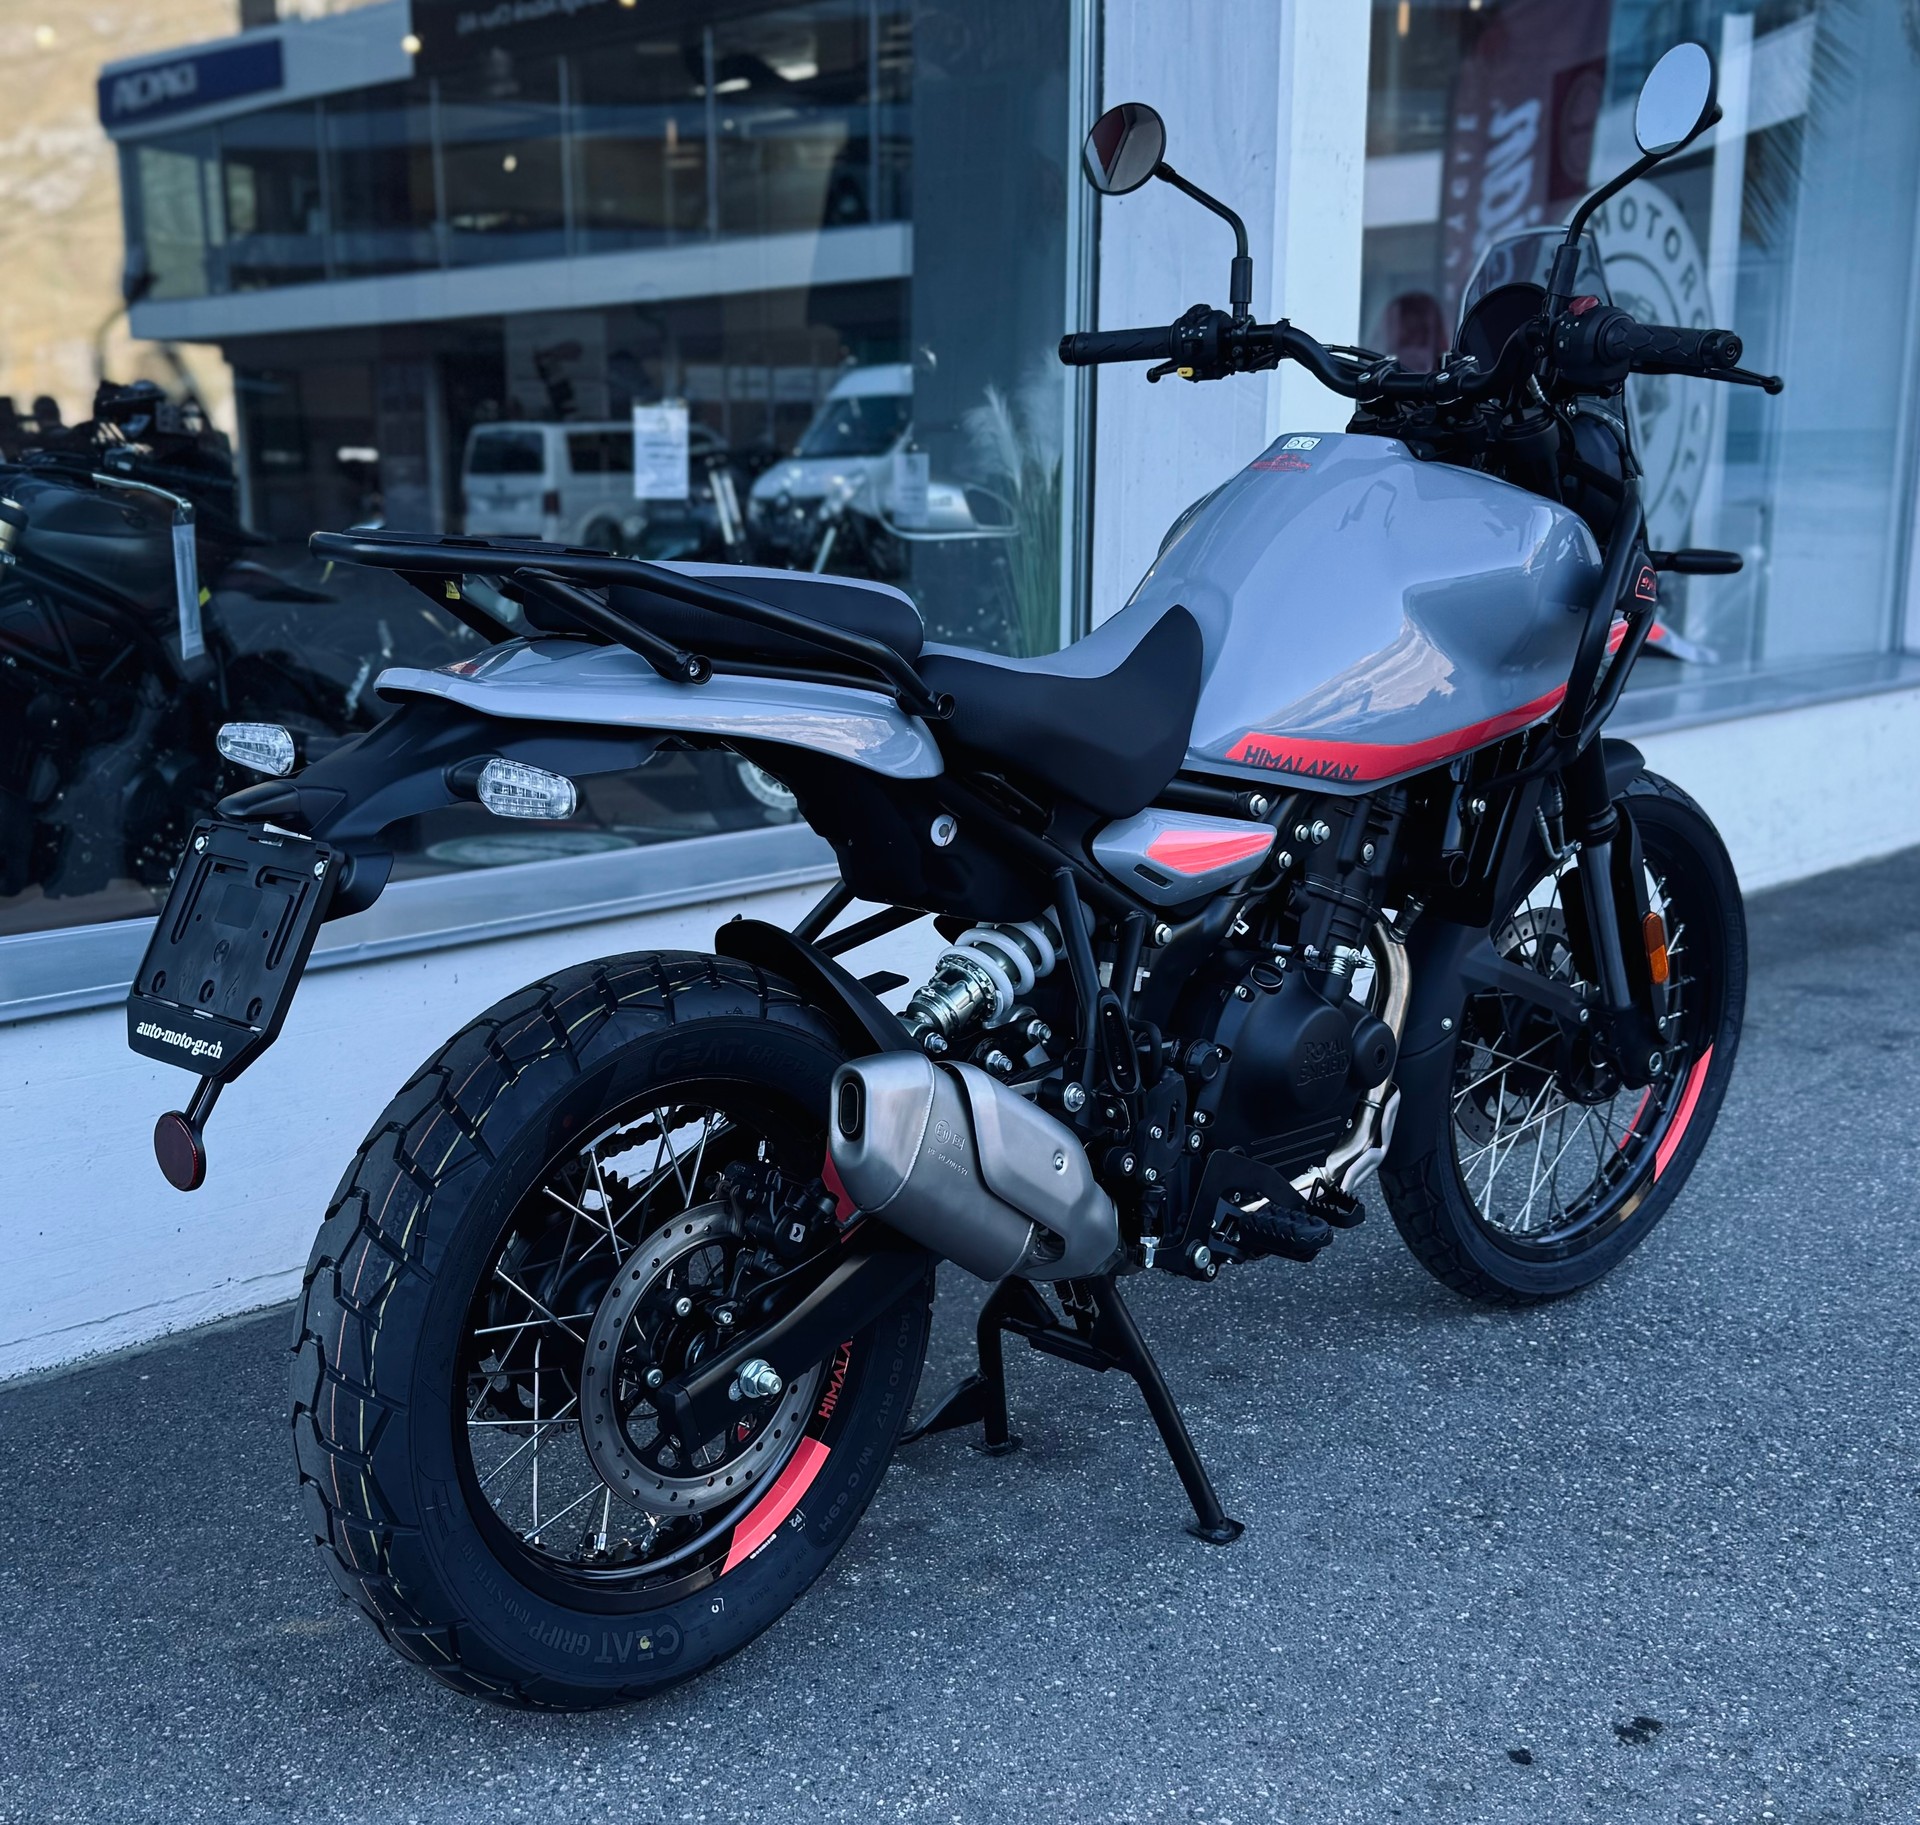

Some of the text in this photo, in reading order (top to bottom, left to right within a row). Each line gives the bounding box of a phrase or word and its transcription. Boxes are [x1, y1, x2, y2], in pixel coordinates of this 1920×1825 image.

[1243, 744, 1360, 780] HIMALAYAN
[136, 1021, 223, 1060] auto-moto-gr.ch
[1303, 1038, 1347, 1063] ROYAL
[817, 1312, 912, 1534] 140/80 R17 M/C 69H
[527, 1618, 591, 1657] GRIPP
[593, 1623, 680, 1663] CEAT
